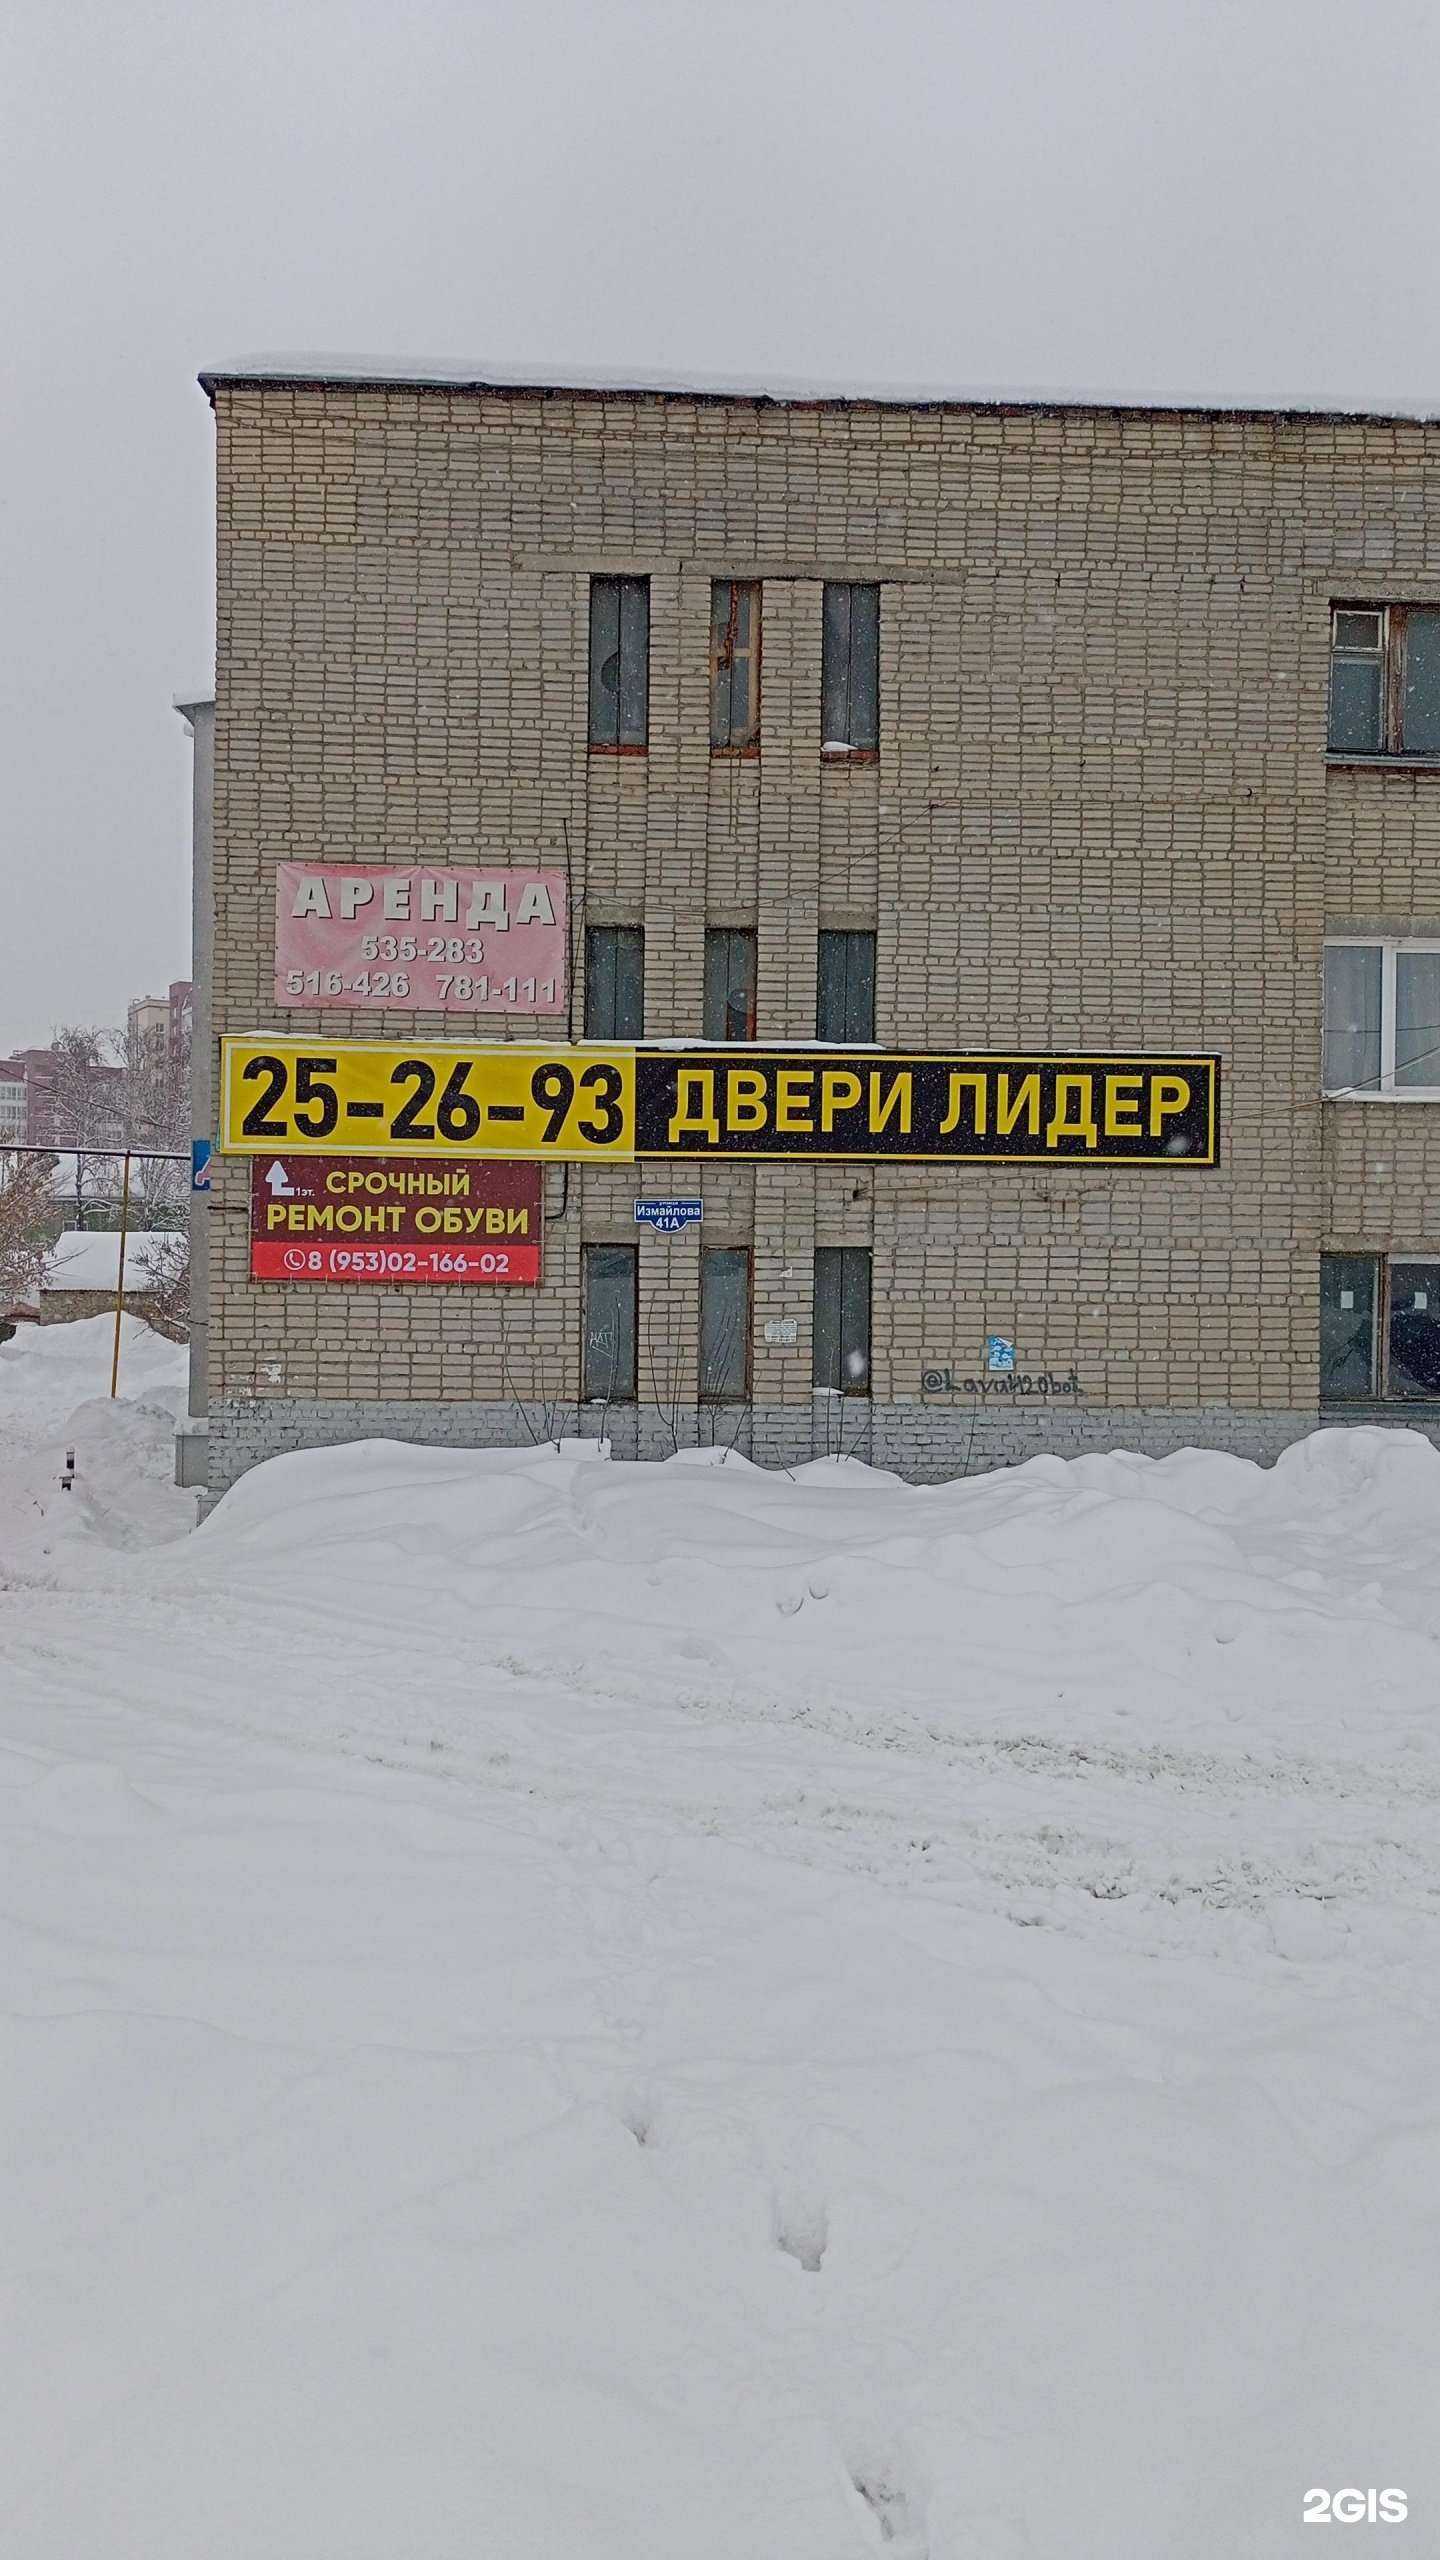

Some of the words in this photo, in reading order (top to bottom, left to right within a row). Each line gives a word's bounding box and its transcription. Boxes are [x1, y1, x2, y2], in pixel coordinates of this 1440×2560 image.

[291, 877, 556, 932] АРЕНДА
[360, 934, 484, 964] 535-283
[285, 969, 411, 998] 516-426
[435, 973, 556, 1003] 781-111
[242, 1055, 624, 1145] 25-26-93
[668, 1069, 912, 1143] ДВЕРИ
[939, 1072, 1191, 1149] ЛИДЕР
[325, 1168, 470, 1196] СРОЧНЫЙ
[267, 1204, 406, 1233] РЕМОНТ
[415, 1206, 529, 1235] ОБУВИ
[636, 1205, 701, 1217] Измайлова
[655, 1217, 680, 1229] 41А
[308, 1250, 323, 1270] 8
[329, 1249, 510, 1274] (953)02-166-02
